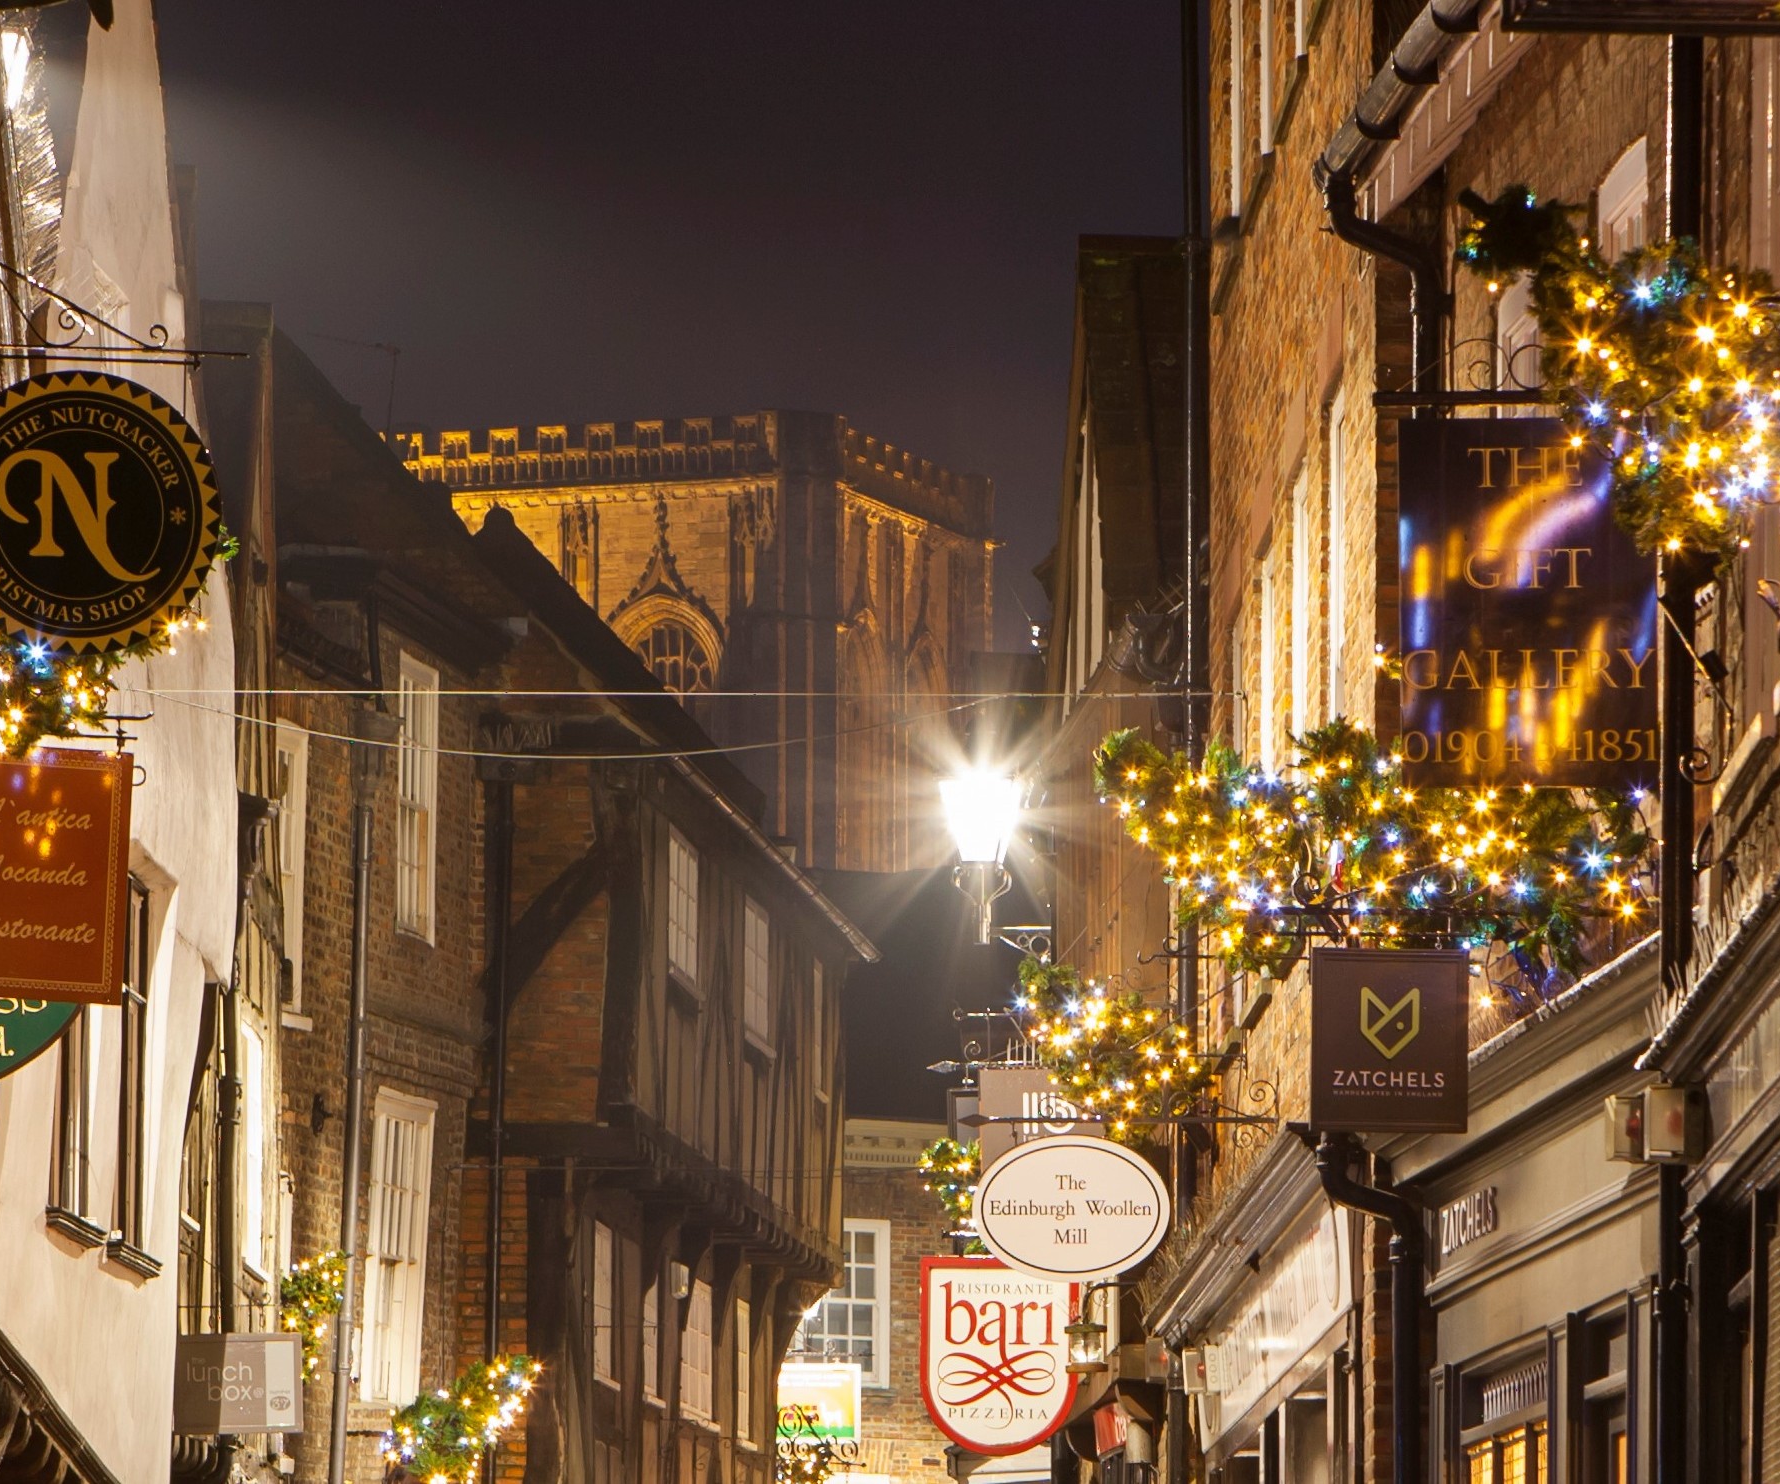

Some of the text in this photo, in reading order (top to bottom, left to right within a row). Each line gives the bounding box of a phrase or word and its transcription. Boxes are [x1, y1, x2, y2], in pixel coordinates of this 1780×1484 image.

[51, 405, 181, 490] NUTCRACKER
[1467, 446, 1584, 488] THE
[1463, 547, 1592, 590] GIFT
[89, 585, 148, 621] SHOP
[1402, 648, 1657, 690] GALLERY
[1332, 1070, 1446, 1089] ZATCHELS
[1054, 1174, 1088, 1191] The
[988, 1199, 1153, 1221] Edinburgh Woollen
[1441, 1186, 1496, 1256] ZATCHELS
[1052, 1228, 1089, 1245] Mill
[957, 1282, 1055, 1296] RISTORANTE
[938, 1280, 1060, 1346] bari
[186, 1361, 253, 1382] lunch
[948, 1406, 1049, 1420] PIZZERIA
